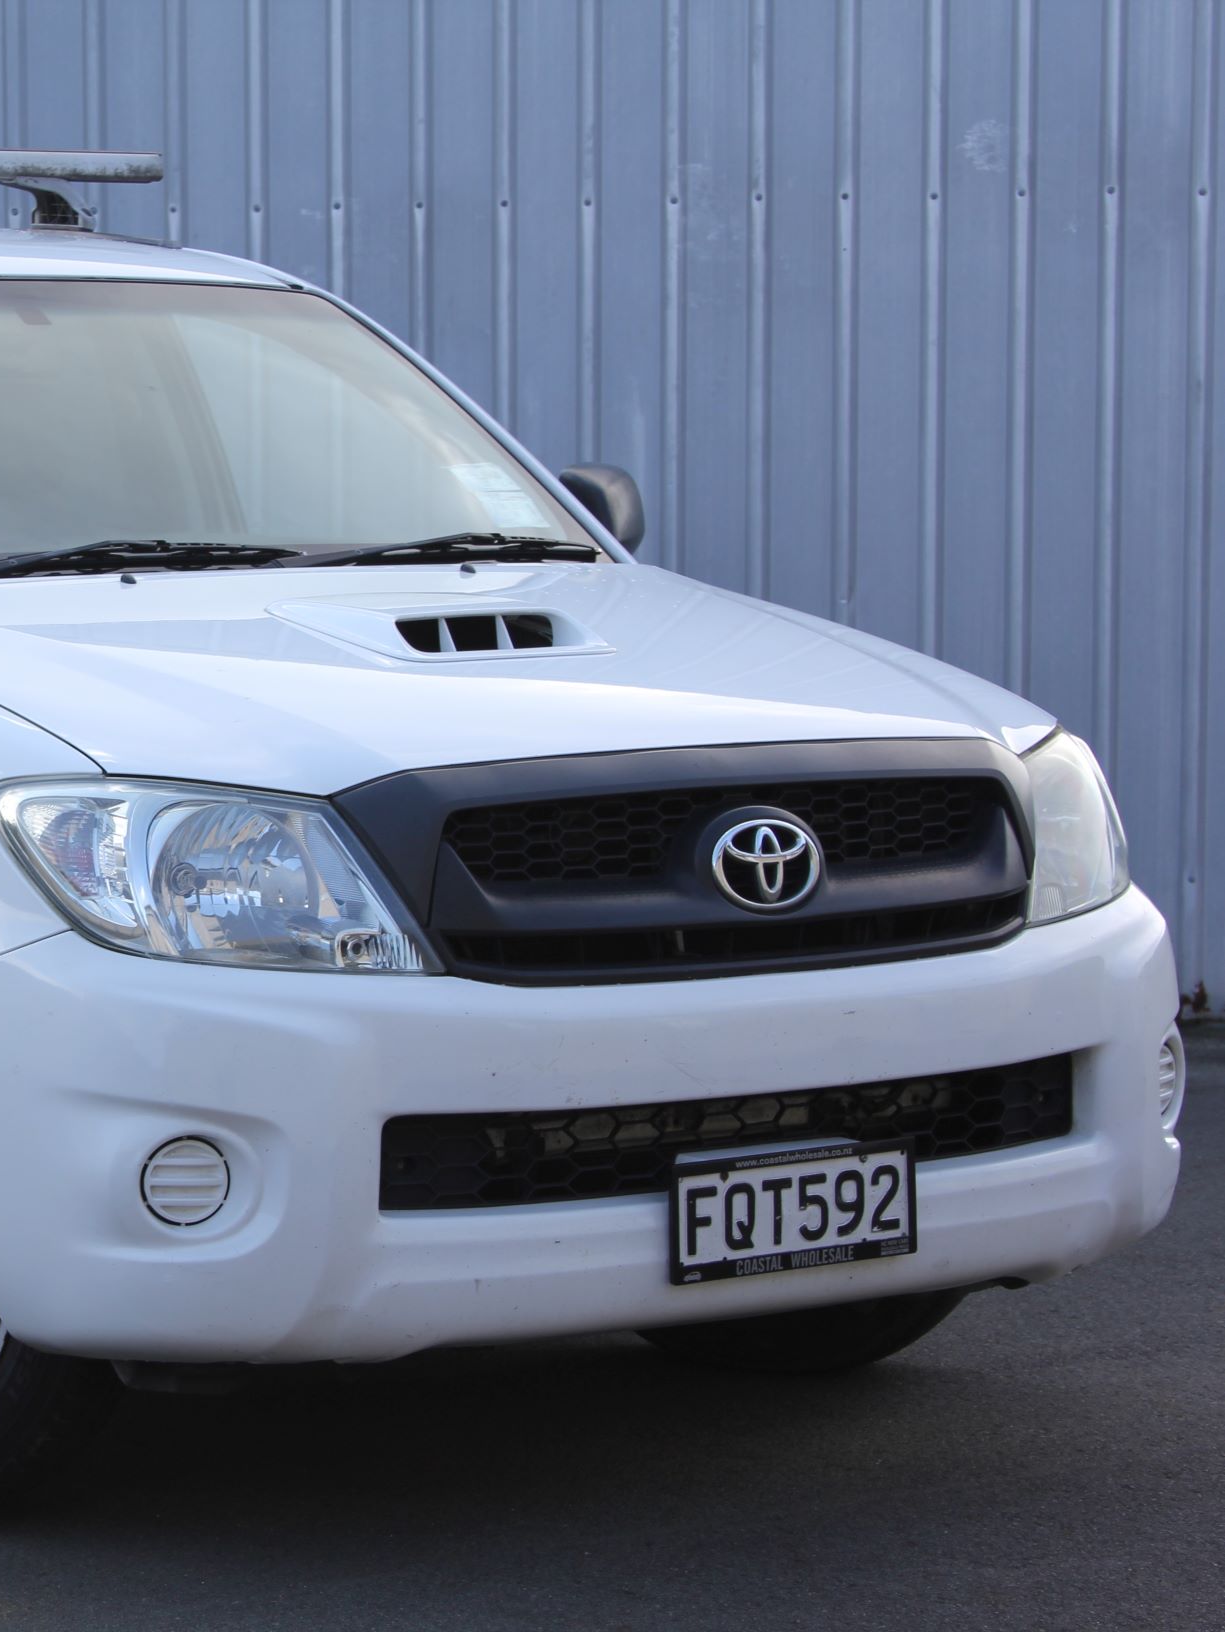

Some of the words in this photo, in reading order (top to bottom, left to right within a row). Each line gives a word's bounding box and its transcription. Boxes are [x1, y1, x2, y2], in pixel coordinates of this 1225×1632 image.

[735, 1147, 853, 1168] www.coastalwholesale.co.nz
[687, 1164, 901, 1256] FQT592
[736, 1256, 783, 1276] COASTAL
[790, 1245, 855, 1269] WHOLESALE
